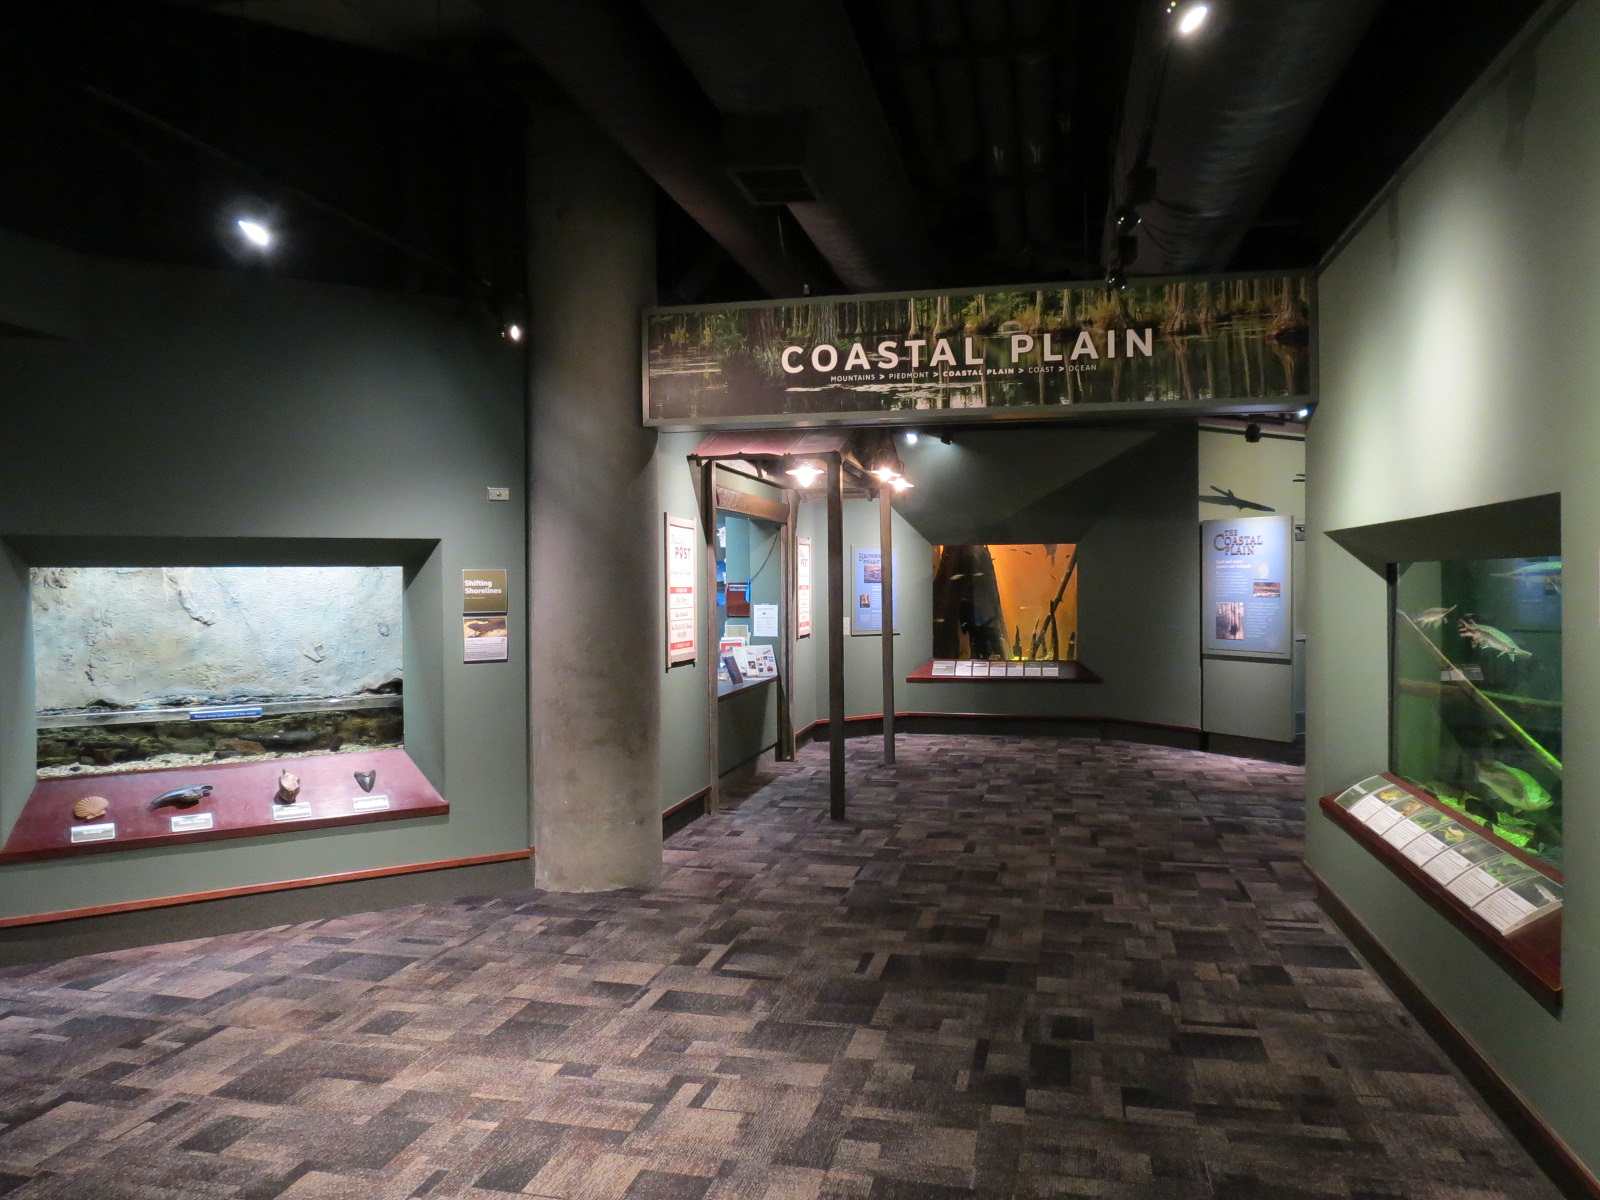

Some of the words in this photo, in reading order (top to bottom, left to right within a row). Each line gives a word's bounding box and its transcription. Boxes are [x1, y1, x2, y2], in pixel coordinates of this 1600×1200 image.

[781, 337, 984, 374] COASTAL
[1011, 328, 1153, 363] PLAIN
[830, 374, 876, 383] MOUNTAINS
[888, 371, 929, 380] PIEDMONT
[942, 369, 984, 378] COASTAL
[986, 368, 1015, 376] PLAIN
[1028, 366, 1055, 374] COAST
[1068, 364, 1097, 372] OCEAN
[1224, 529, 1238, 537] THE
[1213, 533, 1262, 551] COASTAL
[675, 546, 691, 560] POST
[1224, 545, 1255, 556] PLAIN
[464, 580, 492, 588] Shifting
